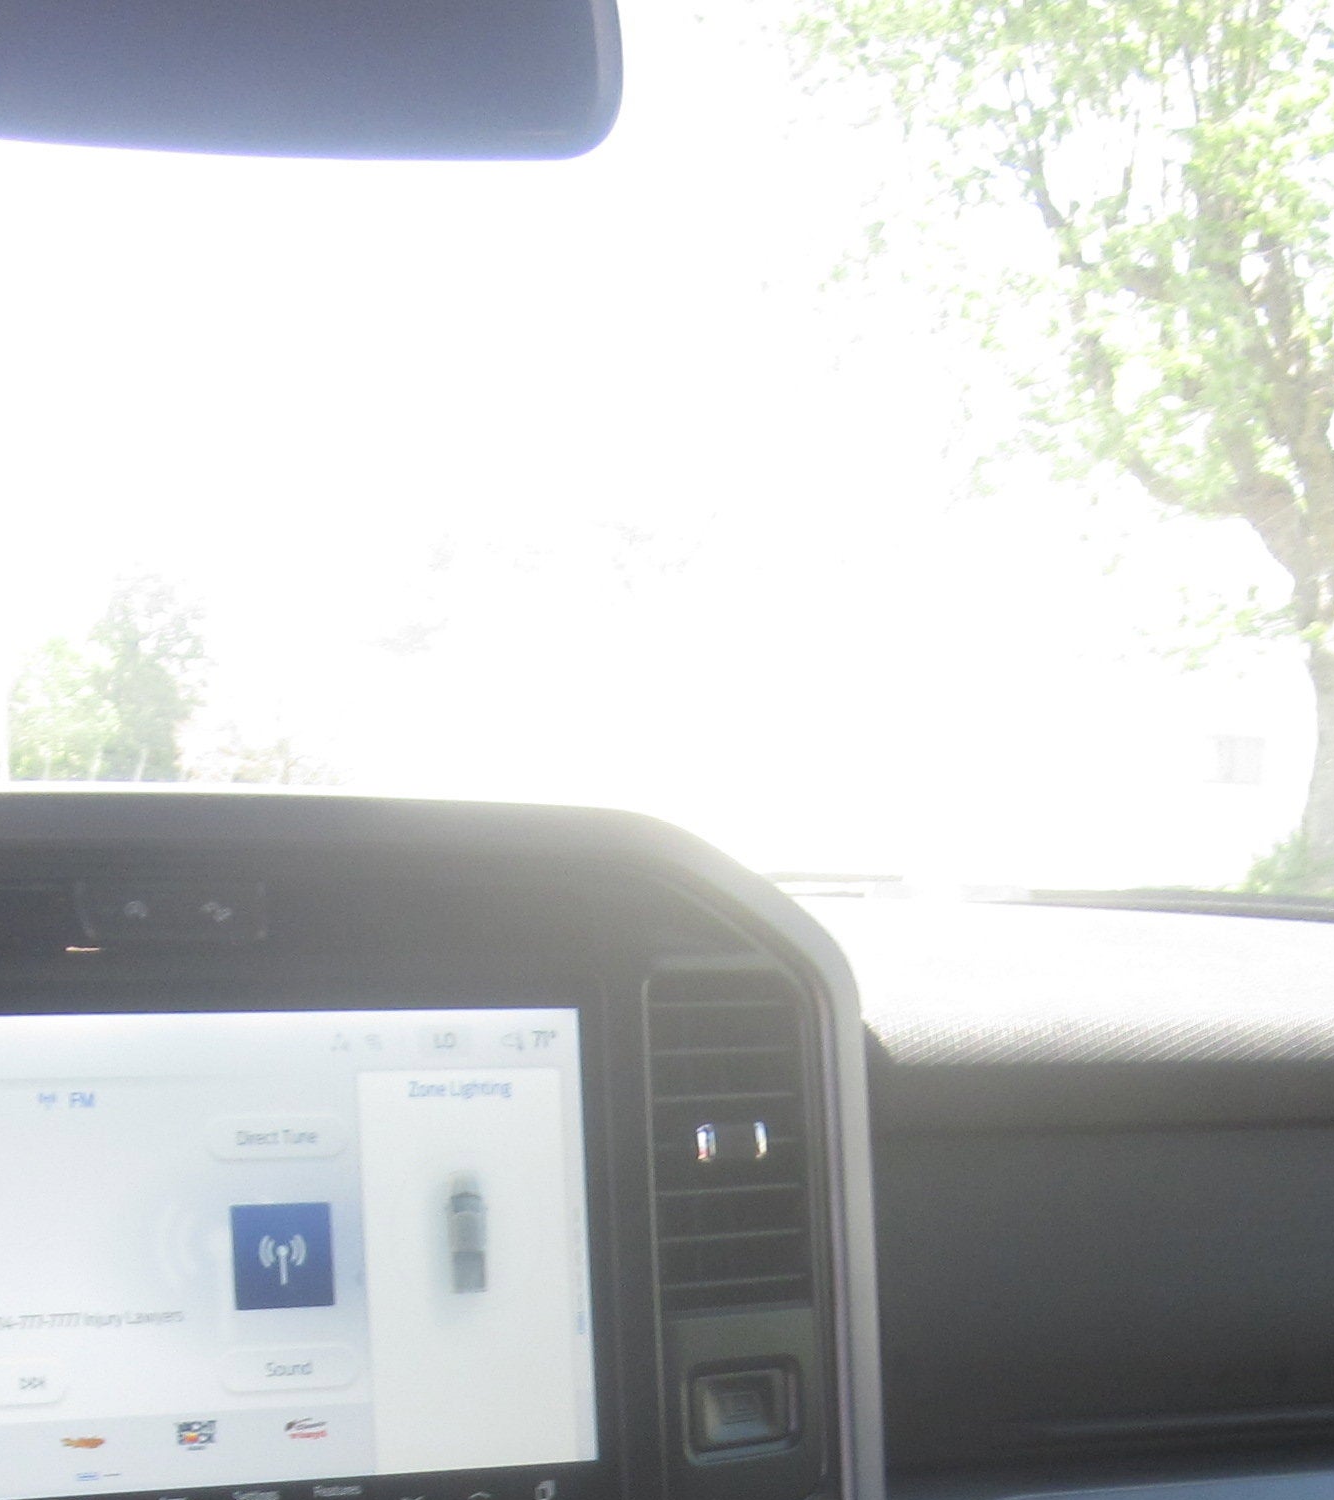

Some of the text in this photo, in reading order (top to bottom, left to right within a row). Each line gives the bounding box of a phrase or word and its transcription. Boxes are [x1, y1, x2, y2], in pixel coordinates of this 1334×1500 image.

[408, 1079, 513, 1100] Zone Lighting
[69, 1091, 95, 1109] FM
[265, 1361, 314, 1378] Sound
